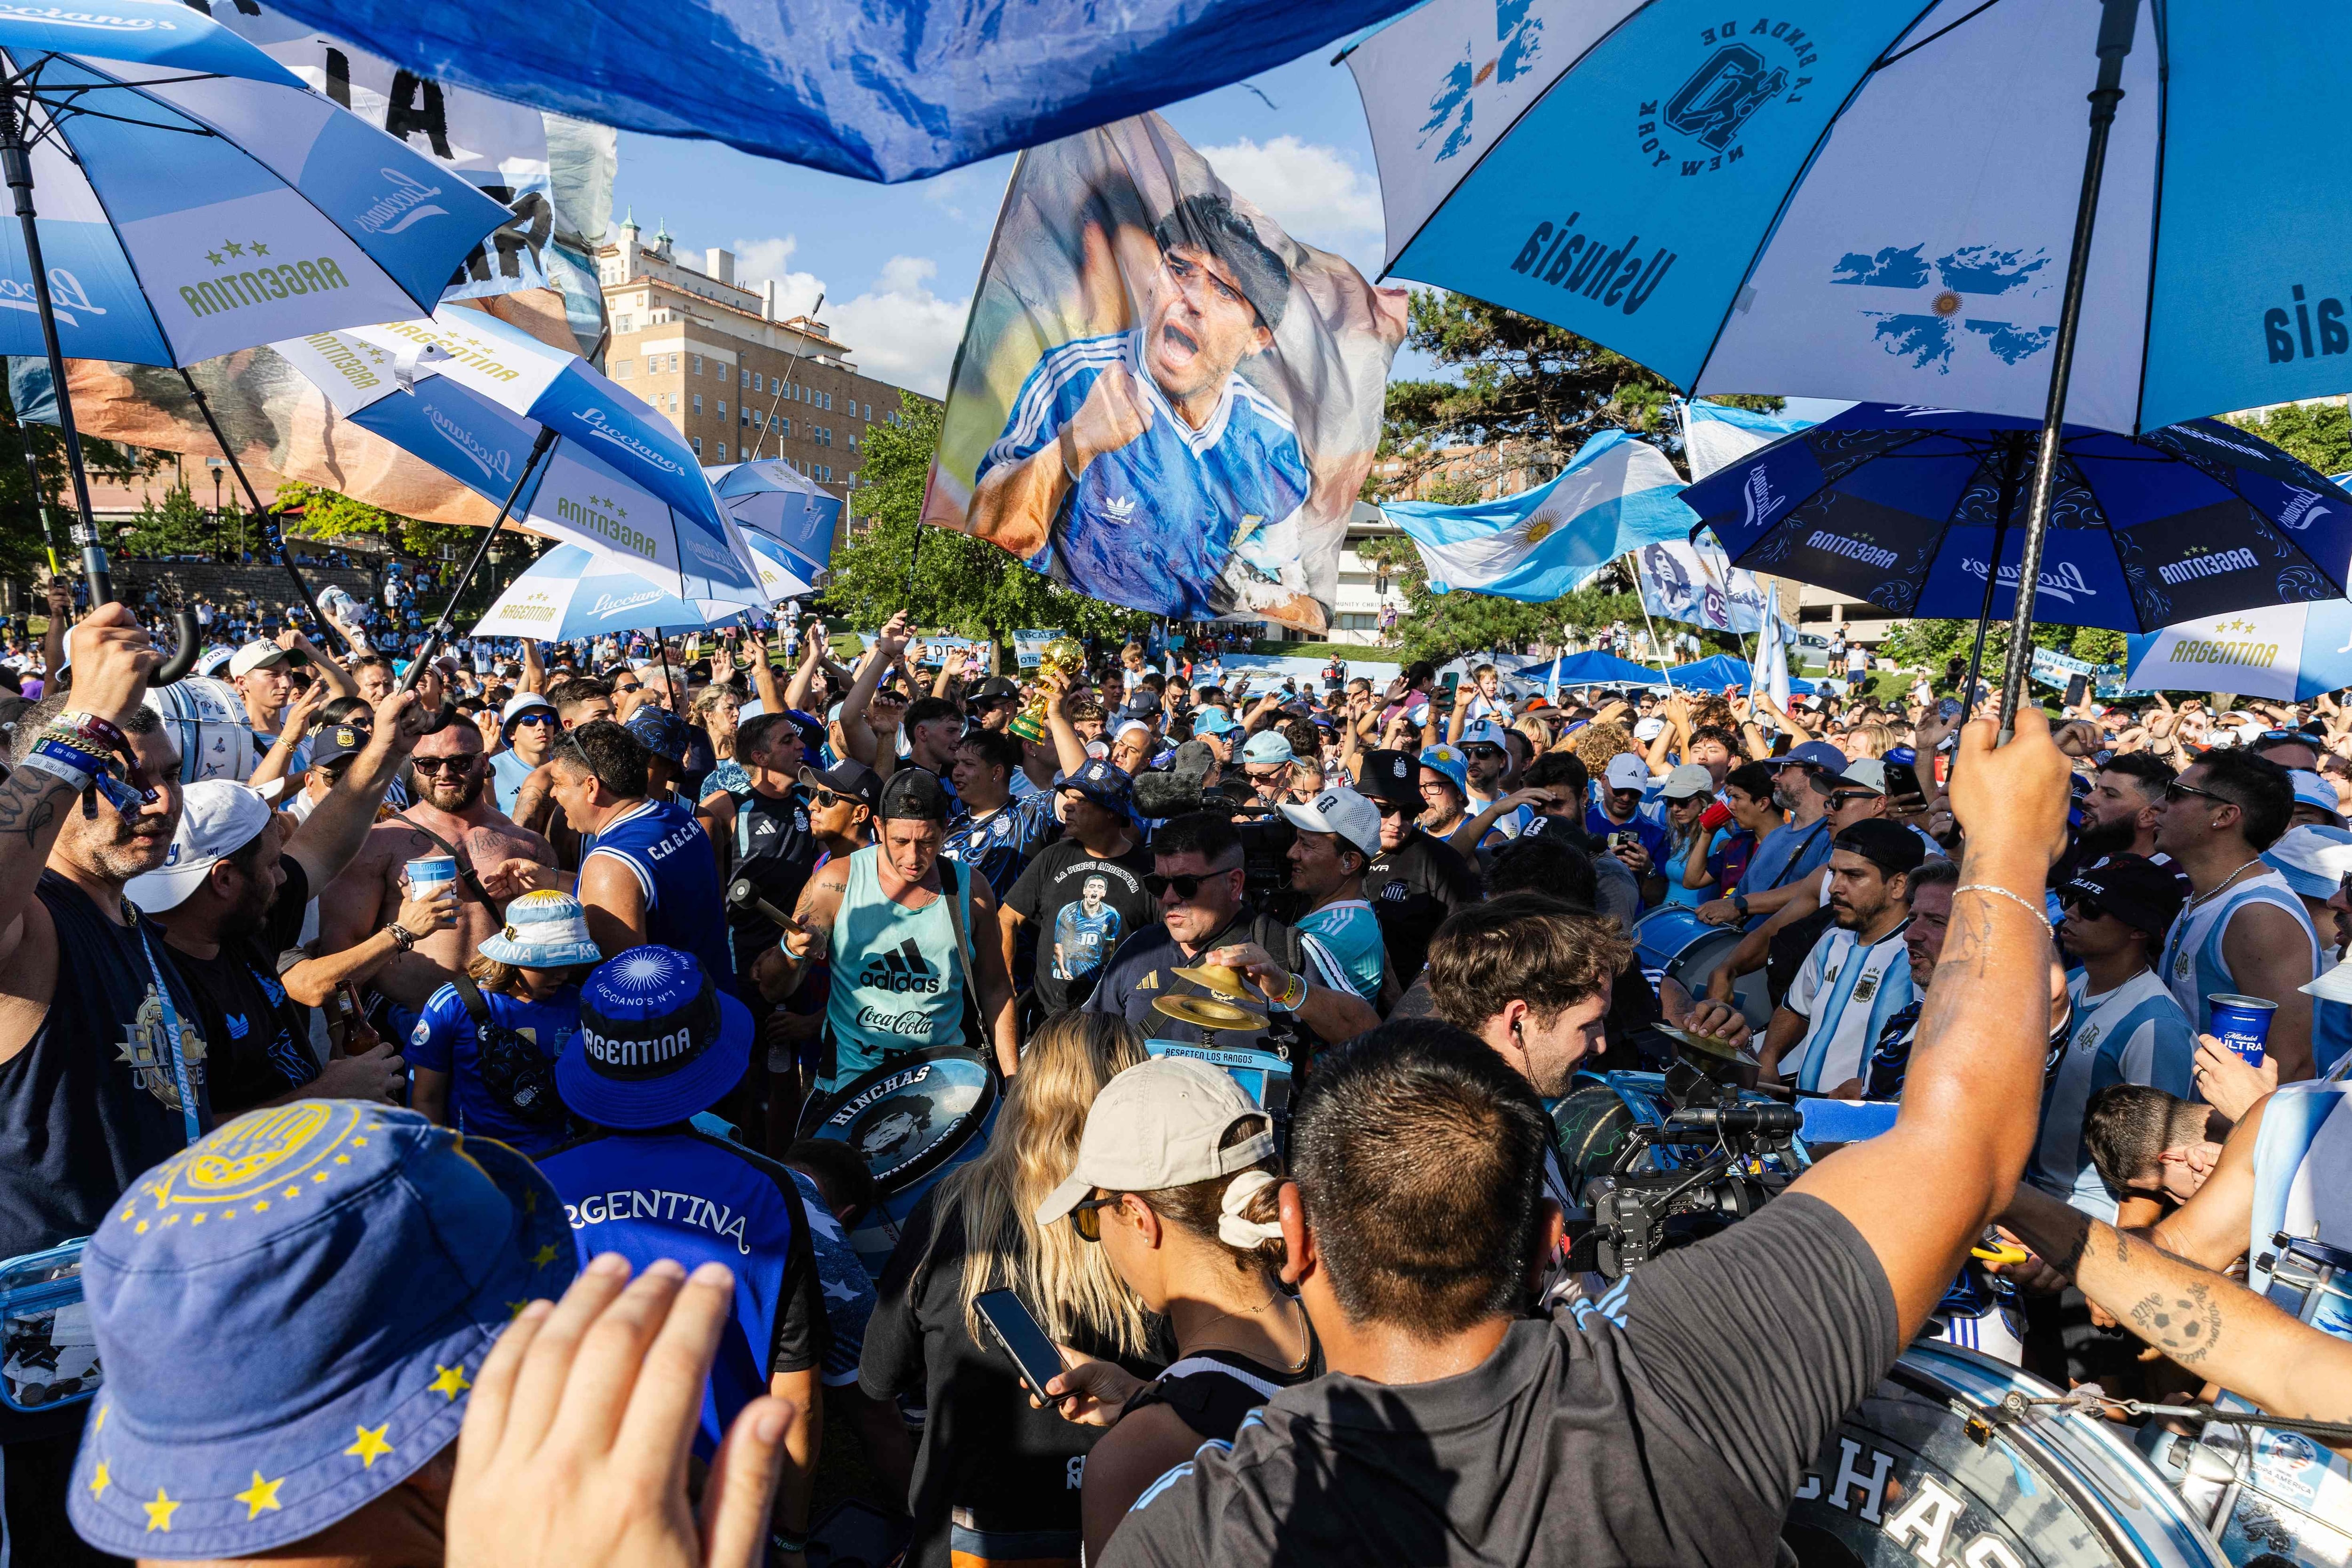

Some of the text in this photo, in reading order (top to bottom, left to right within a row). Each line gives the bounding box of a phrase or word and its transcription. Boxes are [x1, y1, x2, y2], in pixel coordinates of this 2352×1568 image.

[572, 408, 685, 477] Lucciano's
[499, 605, 556, 622] ARGENTINA
[2170, 641, 2279, 669] ARGENTINA
[1055, 861, 1139, 894] LA PERCU ARGENTINA
[1081, 933, 1099, 946] 10
[596, 982, 654, 1006] LUCCIANO'S
[859, 970, 939, 994] adidas
[856, 1005, 932, 1036] Coca-Cola
[2224, 1032, 2257, 1042] Michelob
[171, 1023, 199, 1119] ARGENTINA
[1206, 1051, 1221, 1061] LOS
[1223, 1053, 1253, 1064] RANGOS
[830, 1065, 931, 1126] HINCHAS
[564, 1189, 750, 1255] RGENTINA
